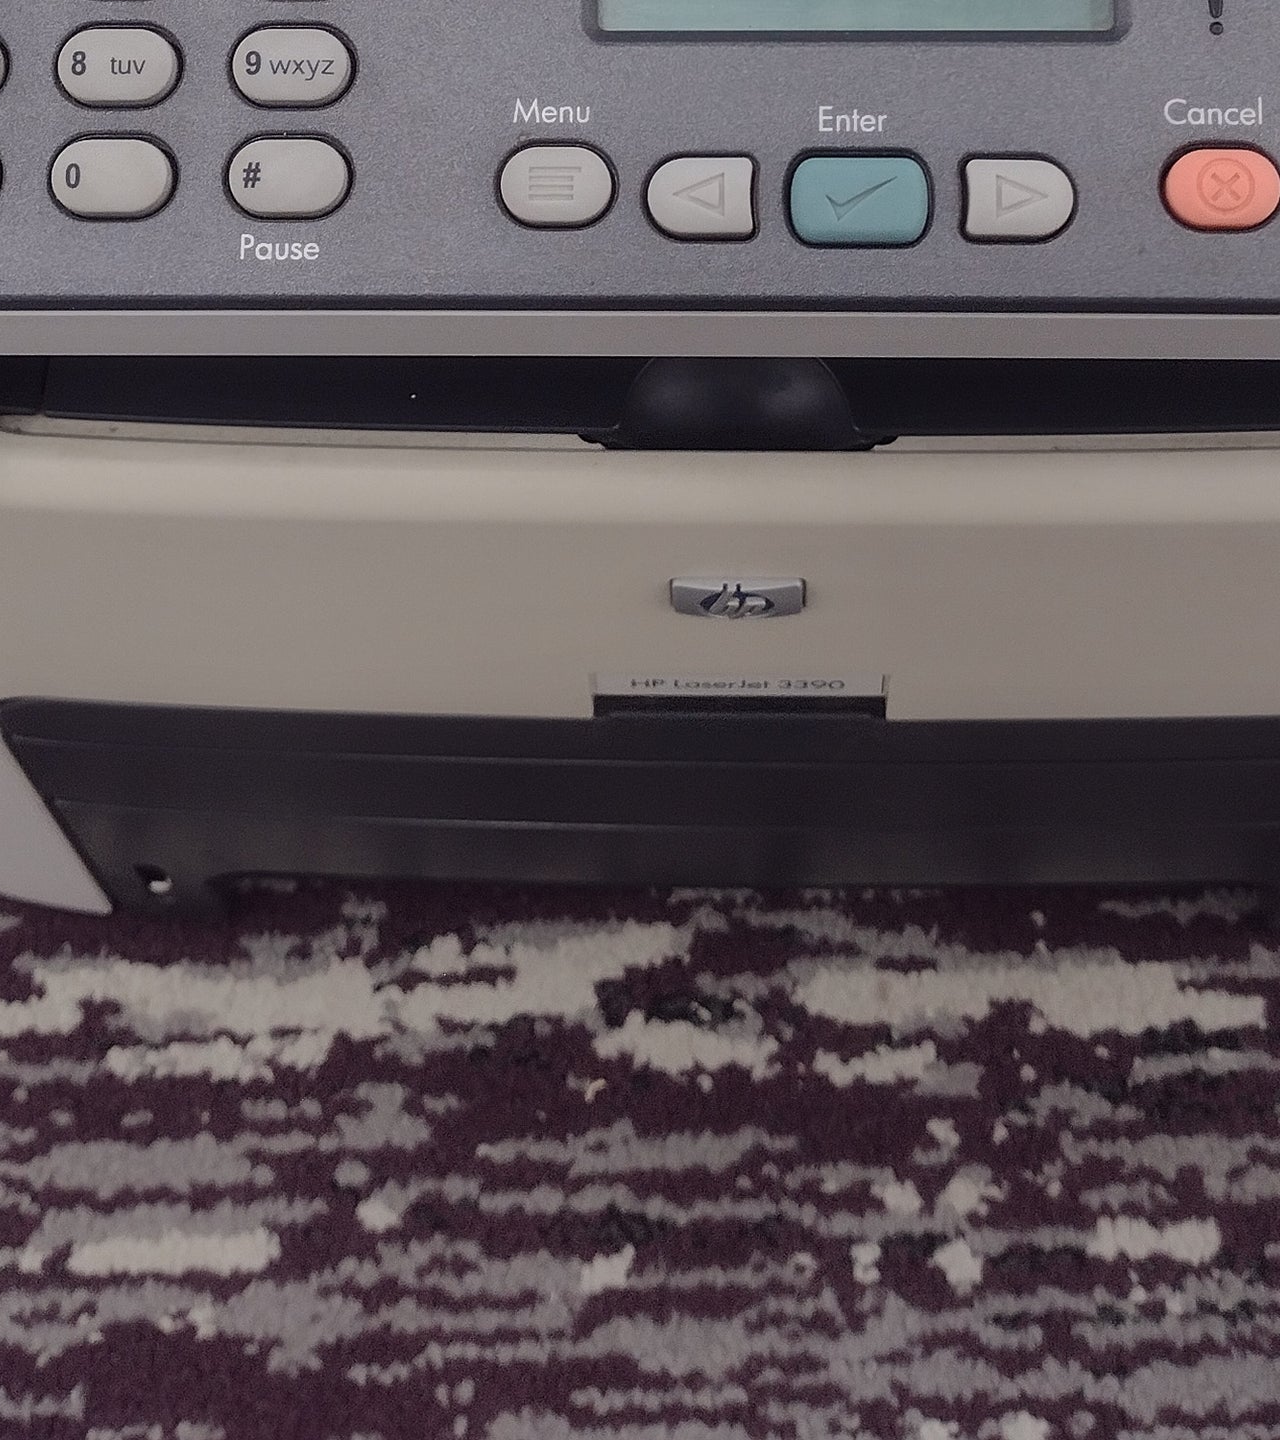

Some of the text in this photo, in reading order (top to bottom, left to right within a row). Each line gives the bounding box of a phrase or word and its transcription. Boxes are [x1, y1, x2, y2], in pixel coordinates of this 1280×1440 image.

[71, 50, 146, 76] 8 tuv
[245, 50, 335, 82] 9 wxyz
[512, 98, 590, 124] Menu
[818, 105, 888, 133] Enter
[1163, 96, 1263, 126] Cancel
[65, 163, 81, 189] 0
[242, 161, 262, 189] #
[239, 233, 320, 261] Pause
